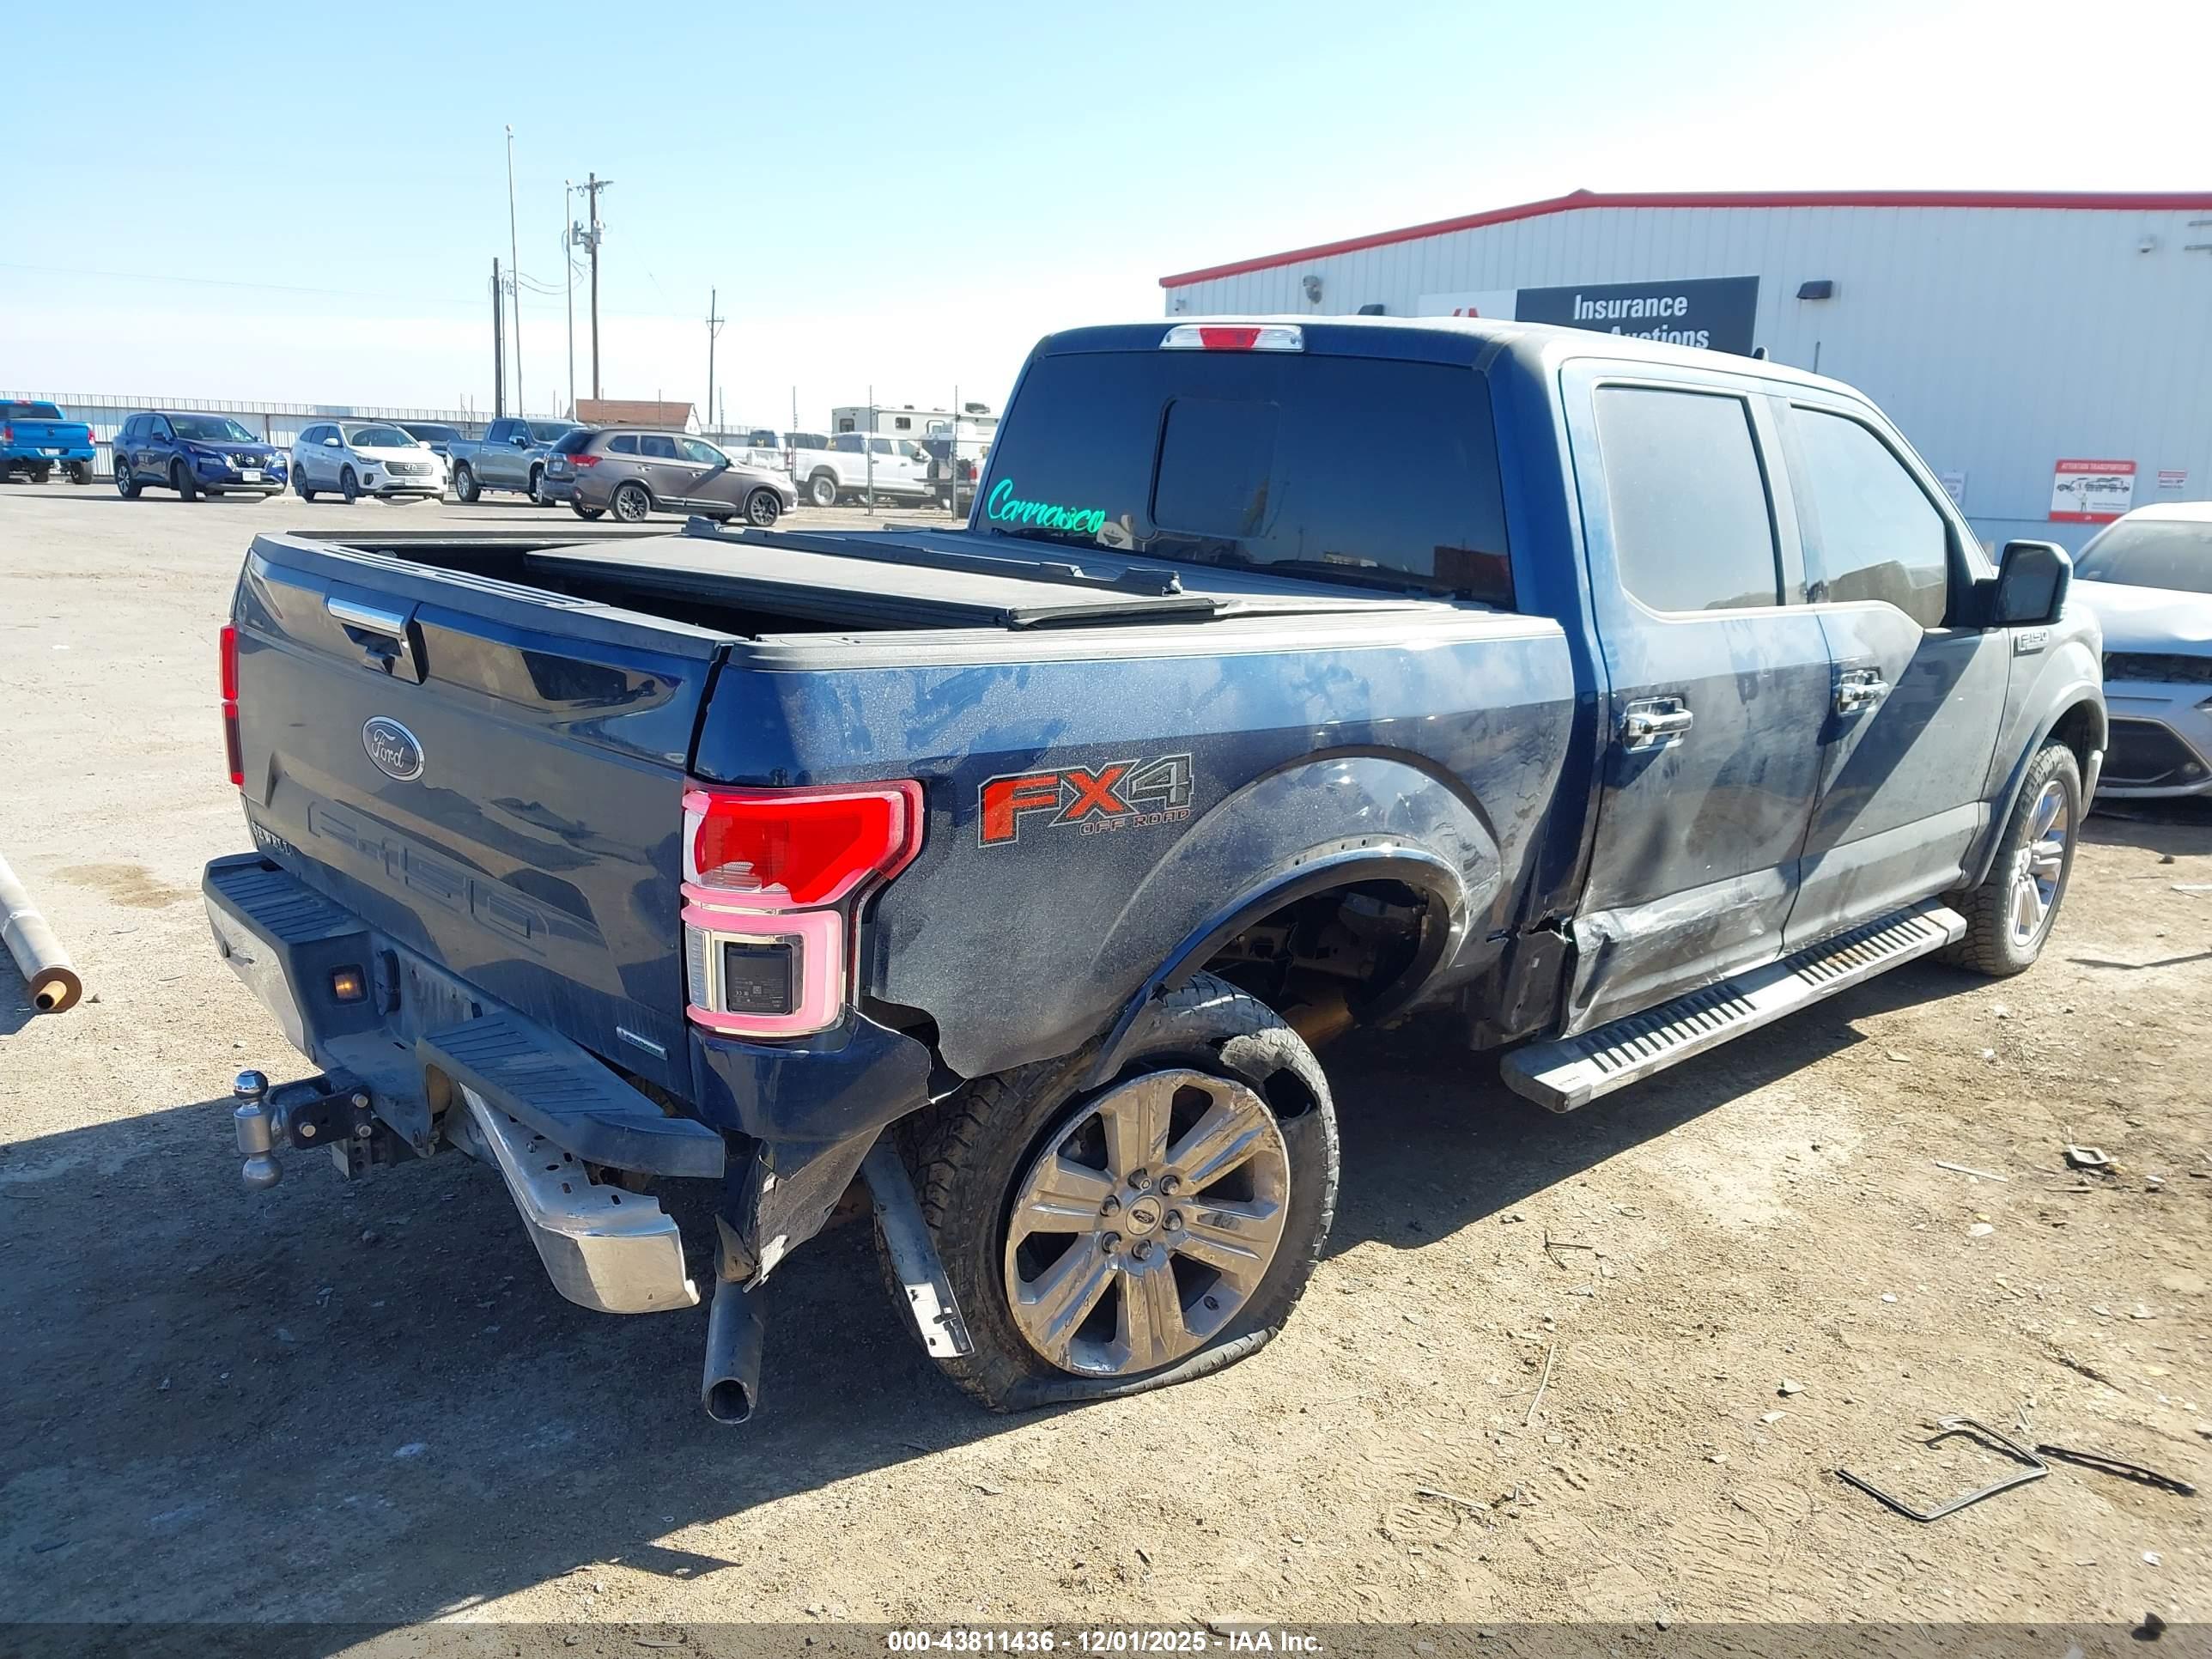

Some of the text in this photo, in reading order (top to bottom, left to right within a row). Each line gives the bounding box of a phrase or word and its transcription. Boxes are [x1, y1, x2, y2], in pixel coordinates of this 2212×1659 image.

[1573, 295, 1688, 319] Insurance
[1610, 325, 1710, 349] tions
[371, 728, 404, 769] Ford
[977, 753, 1194, 848] FX4
[1079, 808, 1191, 836] OFF ROAD
